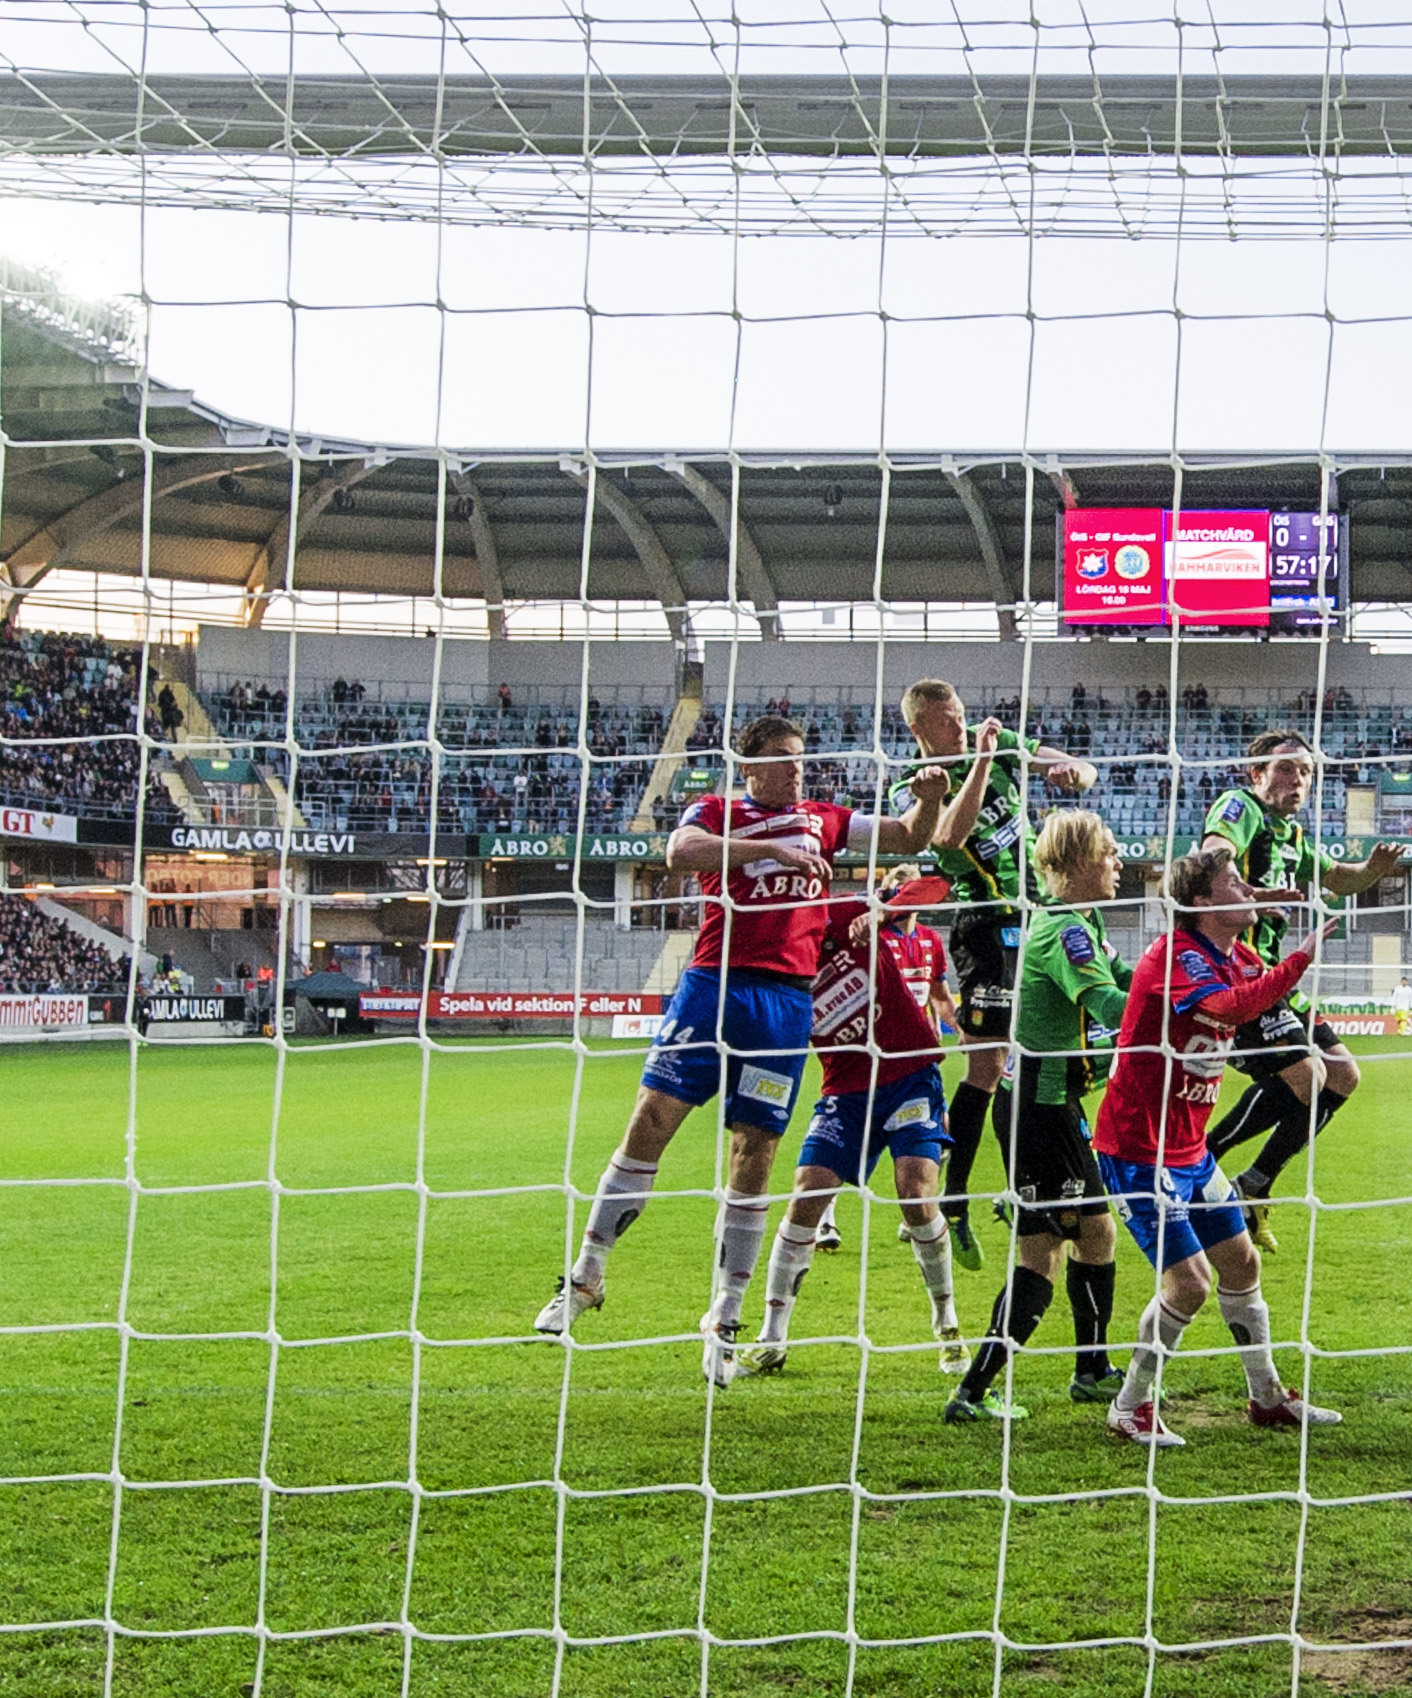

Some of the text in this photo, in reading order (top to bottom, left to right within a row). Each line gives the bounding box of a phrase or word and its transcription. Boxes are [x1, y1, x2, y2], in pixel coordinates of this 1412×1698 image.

[1174, 527, 1254, 541] MATCHVÄRD
[1275, 555, 1332, 575] 57:17
[3, 810, 36, 834] GT
[171, 828, 355, 853] GAMLA ULLEVI
[490, 838, 548, 857] ÅBRO
[589, 838, 648, 857] ÅBRO
[1117, 842, 1146, 858] RO
[749, 875, 822, 899] ÅBRO
[439, 997, 483, 1013] Spela
[486, 997, 511, 1012] vid
[515, 997, 573, 1012] sektion
[590, 997, 626, 1012] eller
[628, 998, 641, 1012] N
